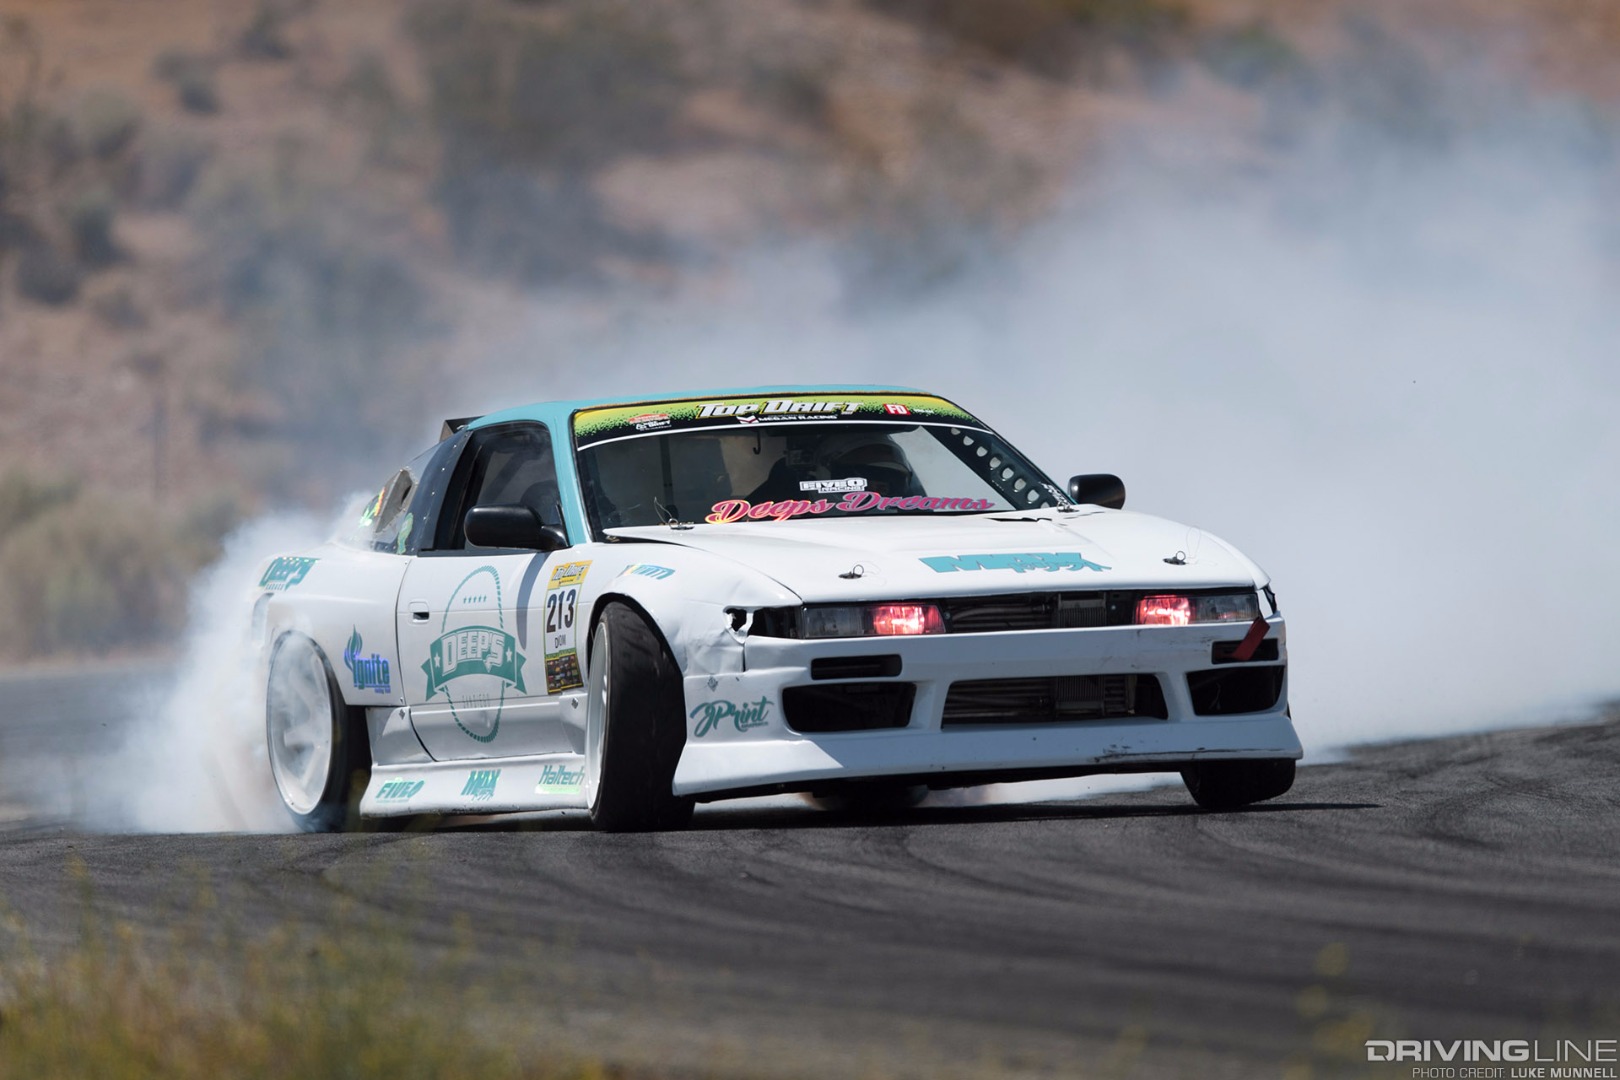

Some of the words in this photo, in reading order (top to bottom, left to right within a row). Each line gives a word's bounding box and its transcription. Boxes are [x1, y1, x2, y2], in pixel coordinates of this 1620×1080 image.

[705, 499, 836, 524] Deeps
[836, 491, 995, 512] Dreams
[546, 588, 577, 633] 213
